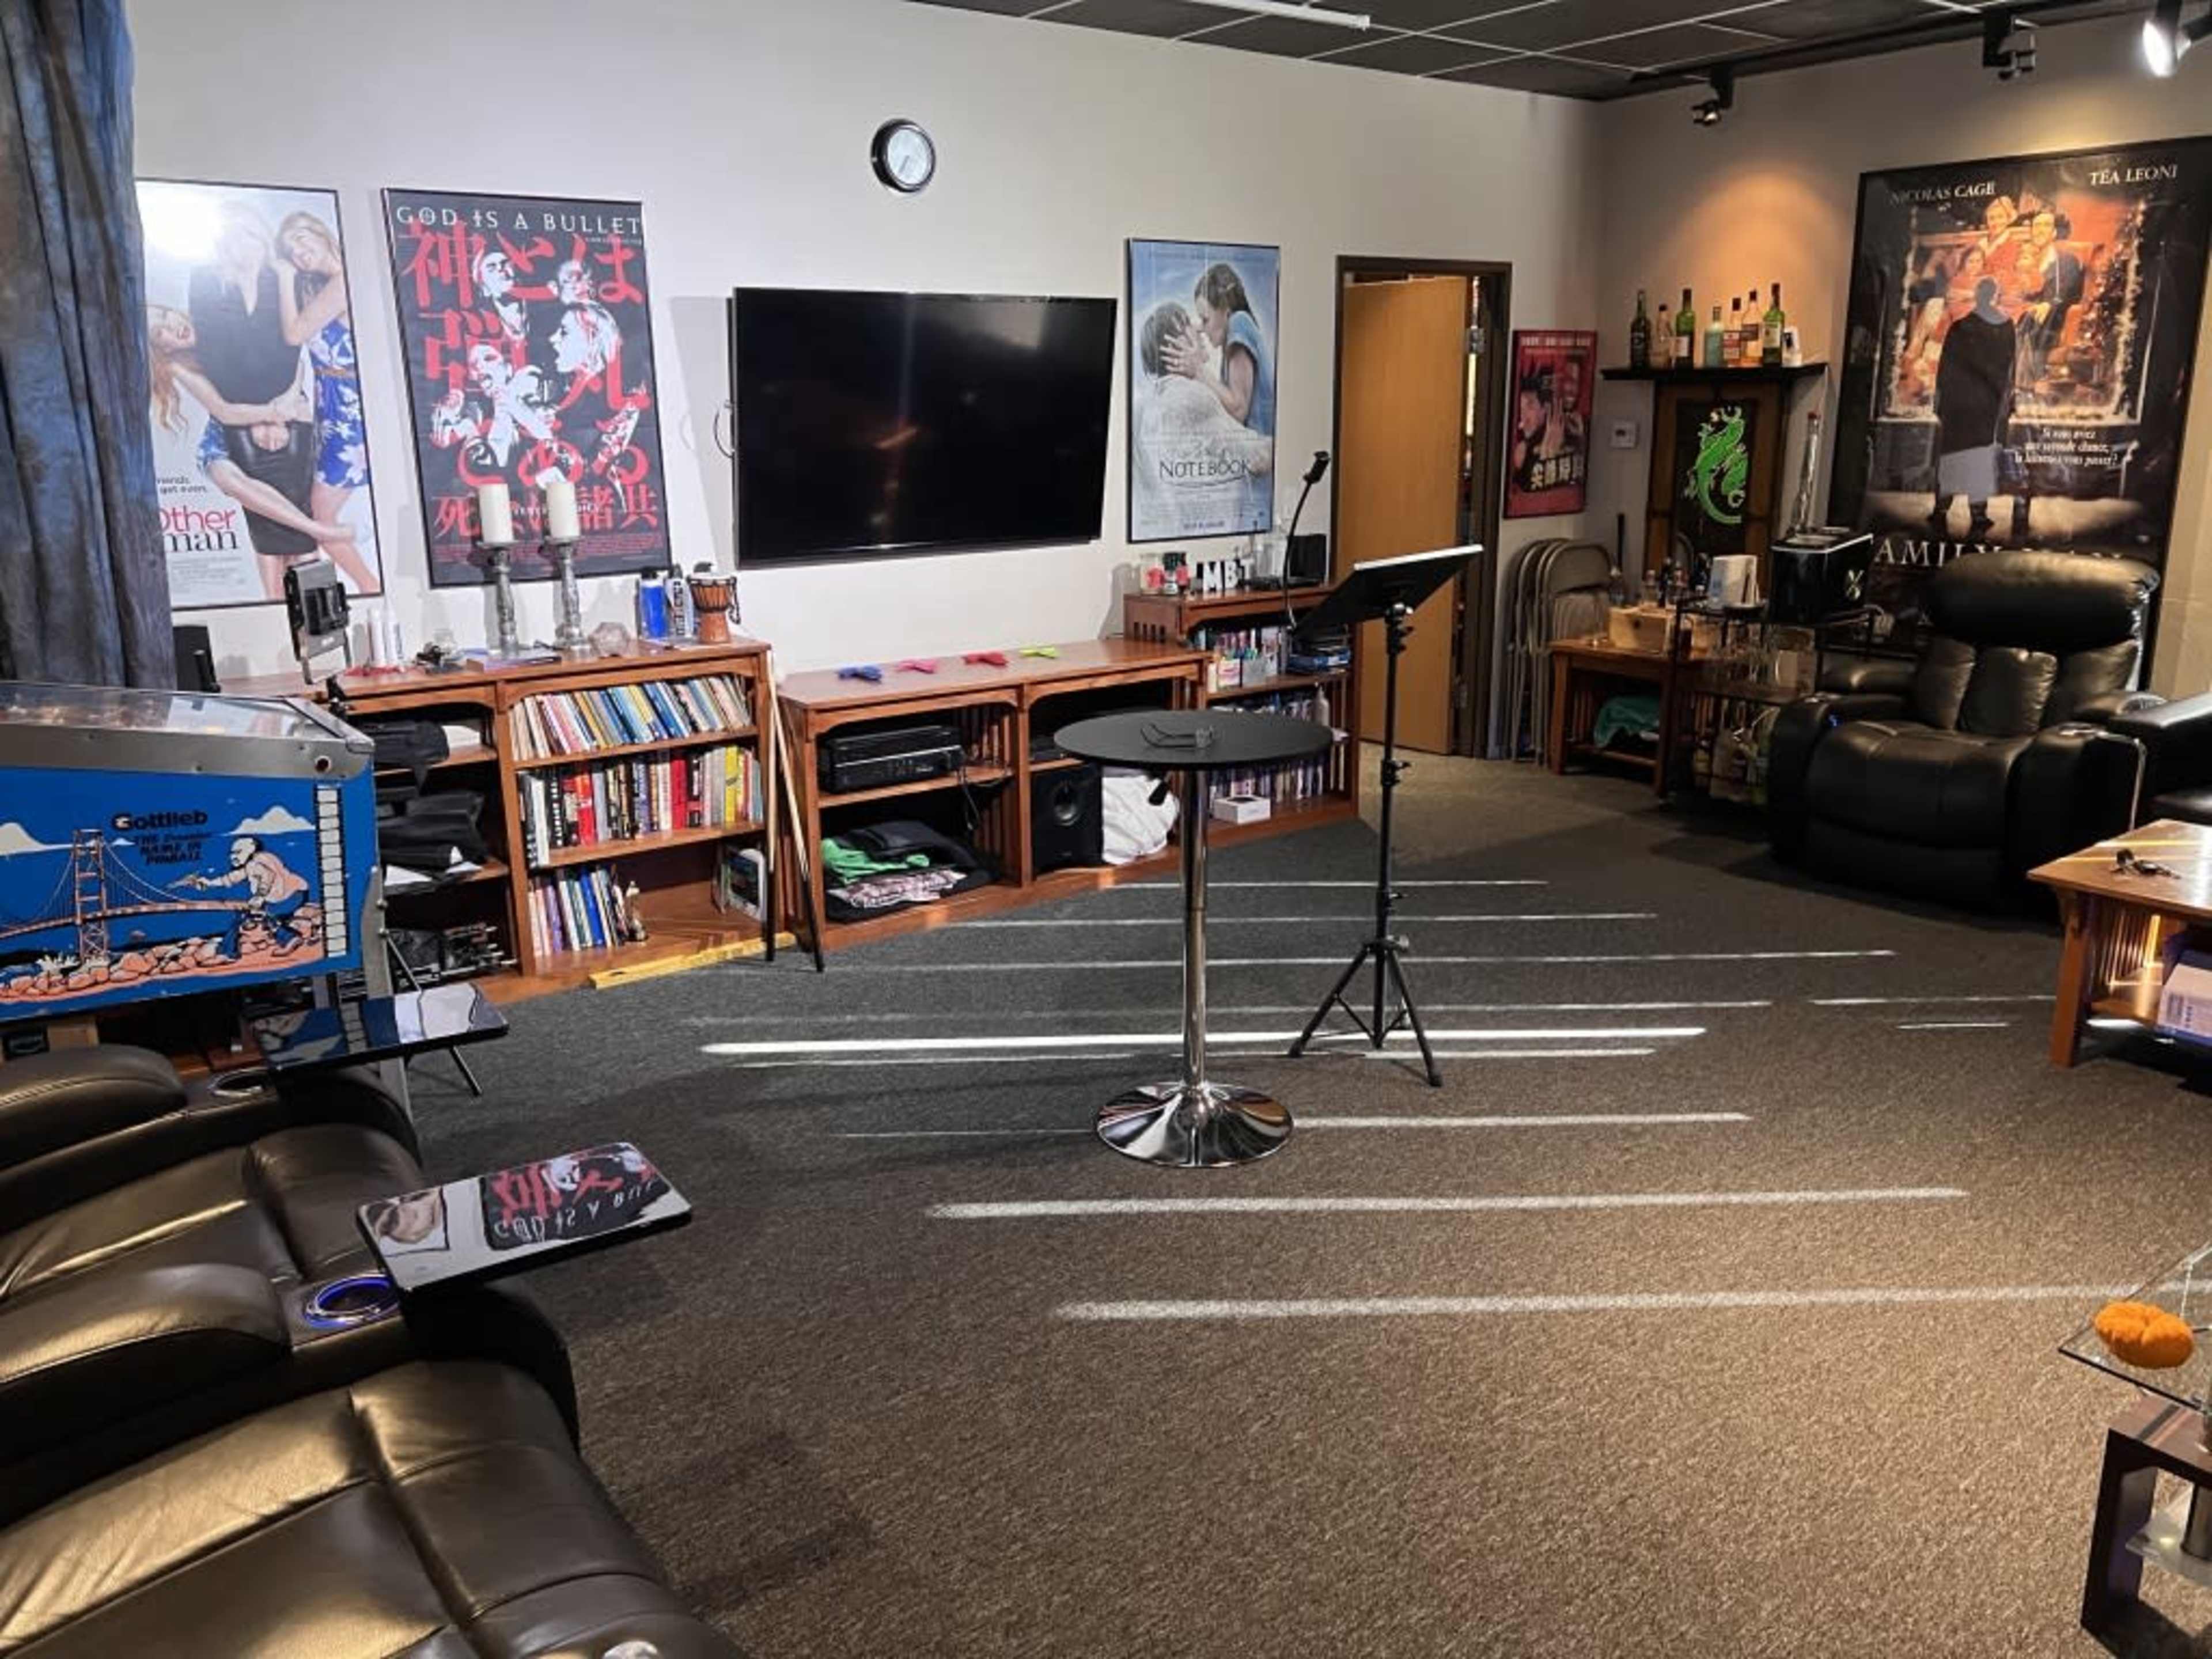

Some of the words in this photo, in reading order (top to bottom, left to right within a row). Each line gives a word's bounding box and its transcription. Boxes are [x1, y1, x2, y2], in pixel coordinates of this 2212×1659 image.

[2126, 164, 2178, 182] LEONI
[1955, 181, 1996, 198] CAGE
[397, 207, 457, 225] GOD
[472, 209, 499, 228] IS
[515, 213, 529, 230] A
[544, 213, 640, 234] BULLET
[1160, 460, 1249, 479] NOTEBOOK
[164, 531, 238, 551] man
[1203, 559, 1255, 590] MBT
[111, 809, 208, 830] Gottlieb
